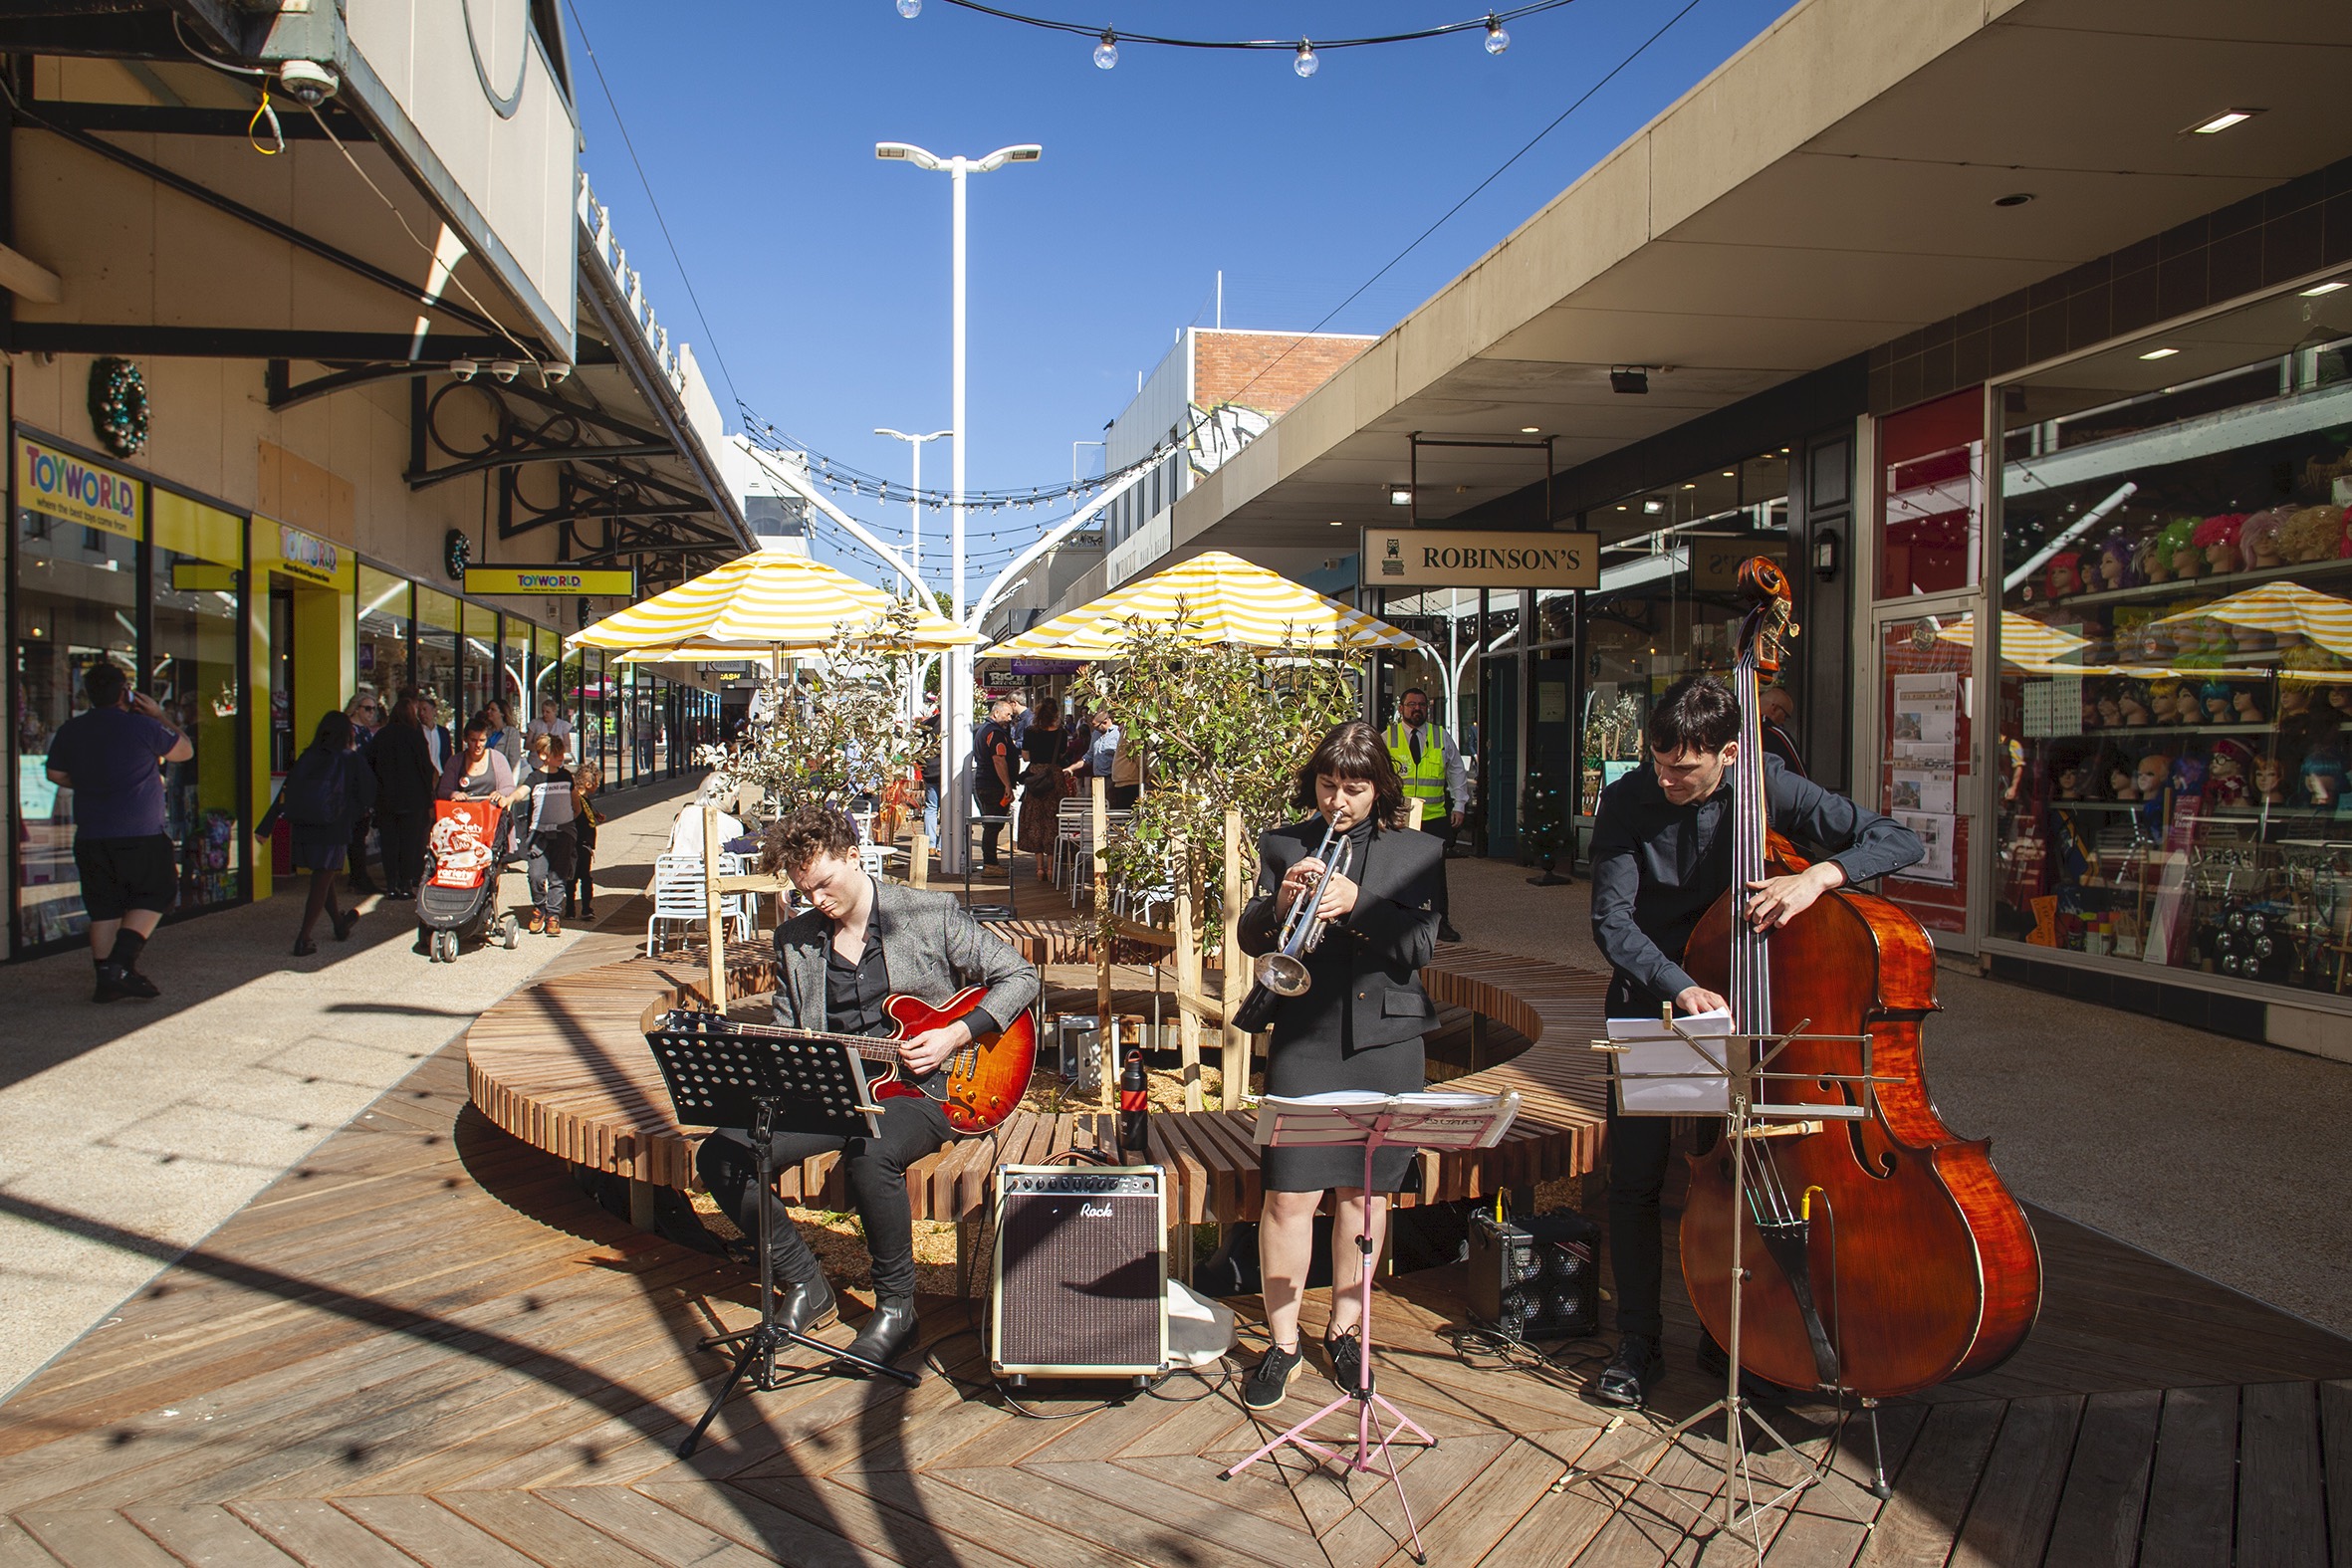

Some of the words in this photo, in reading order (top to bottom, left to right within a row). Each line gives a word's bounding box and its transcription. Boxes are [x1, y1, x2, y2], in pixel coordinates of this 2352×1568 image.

[26, 445, 133, 518] TOYWORLD
[36, 497, 57, 511] where
[58, 502, 68, 516] the
[69, 505, 84, 520] best
[84, 510, 96, 525] toys
[97, 515, 113, 528] come
[114, 518, 127, 533] from
[279, 525, 338, 574] TOYWORLD
[1422, 547, 1581, 570] ROBINSON'S
[517, 574, 581, 587] TOYWORLD
[1080, 1203, 1113, 1219] Rock
